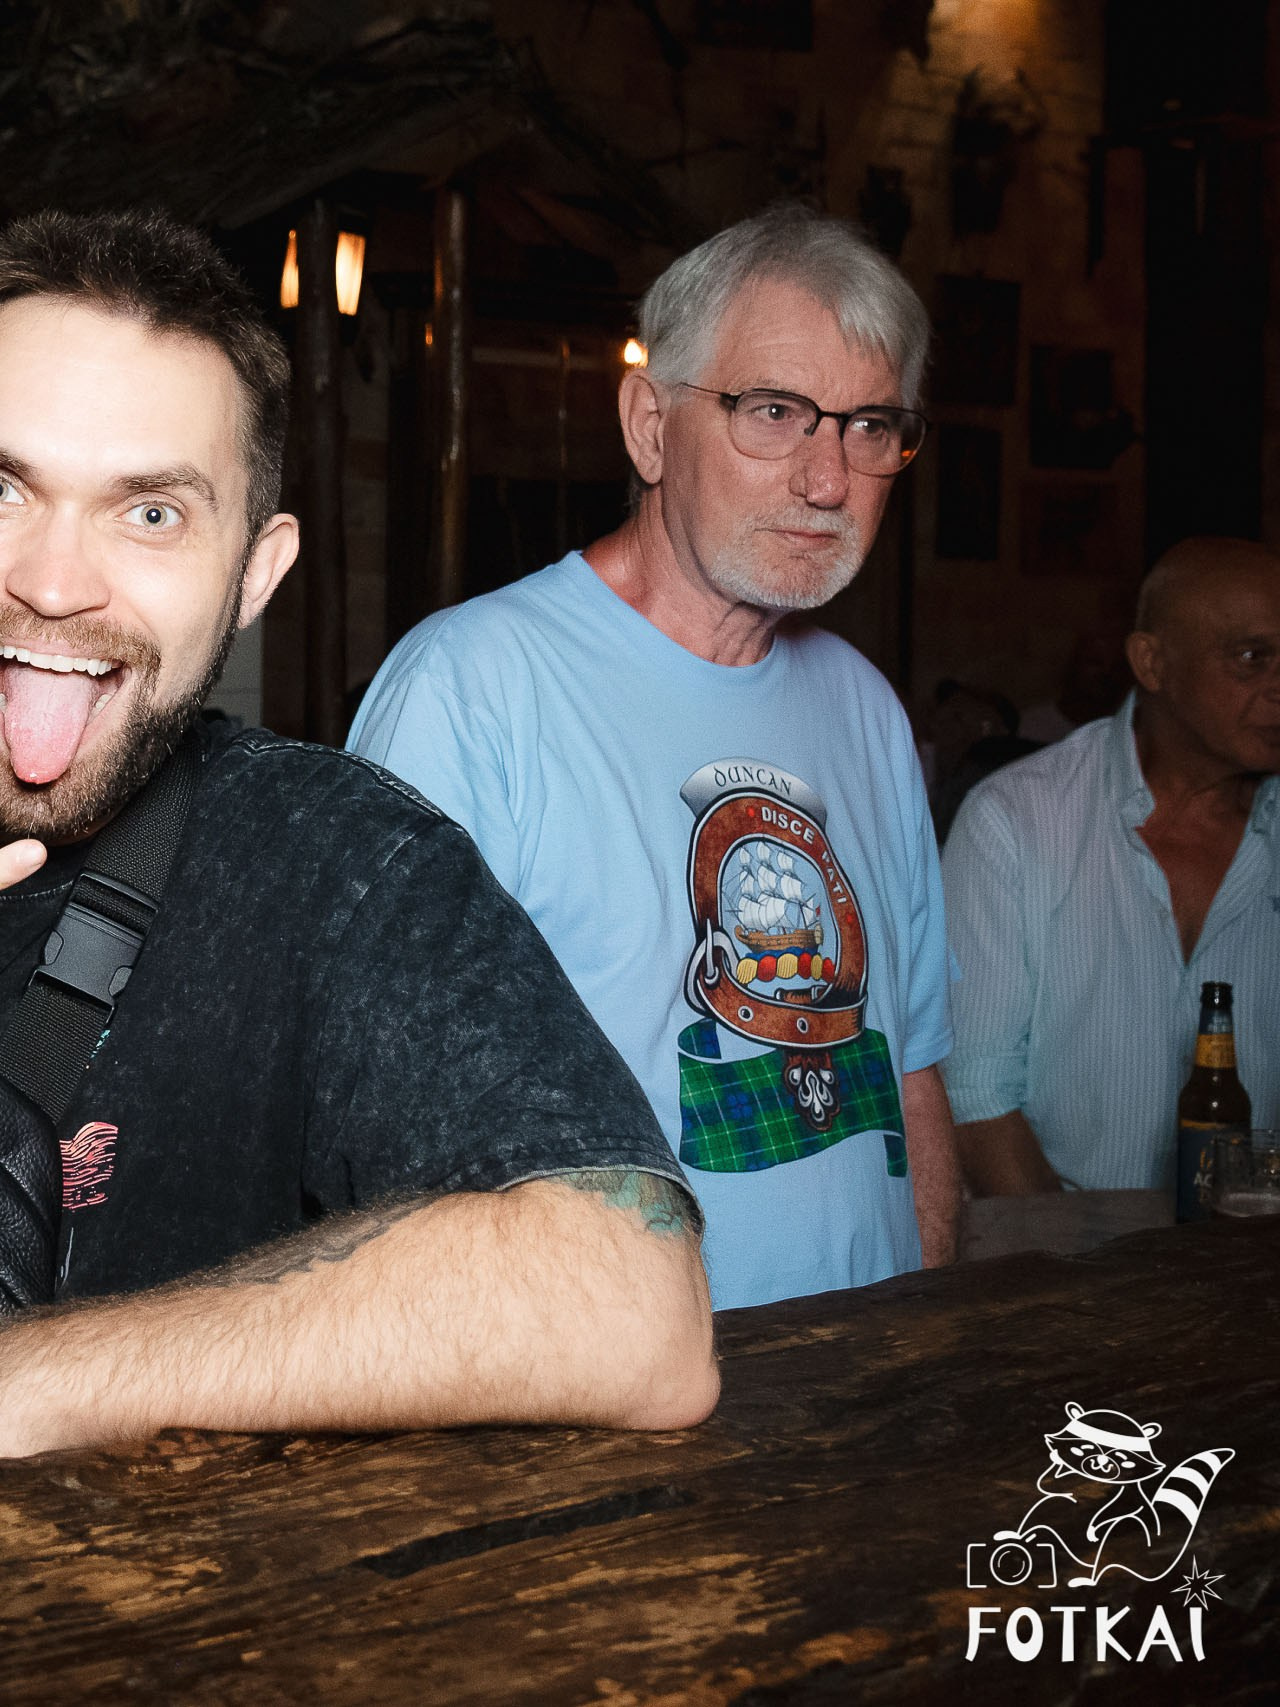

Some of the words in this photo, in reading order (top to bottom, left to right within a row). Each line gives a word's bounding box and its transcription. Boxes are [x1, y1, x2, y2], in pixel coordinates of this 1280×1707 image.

[712, 765, 793, 796] DUNCAN
[760, 805, 816, 846] DISCE
[820, 849, 848, 905] PATI
